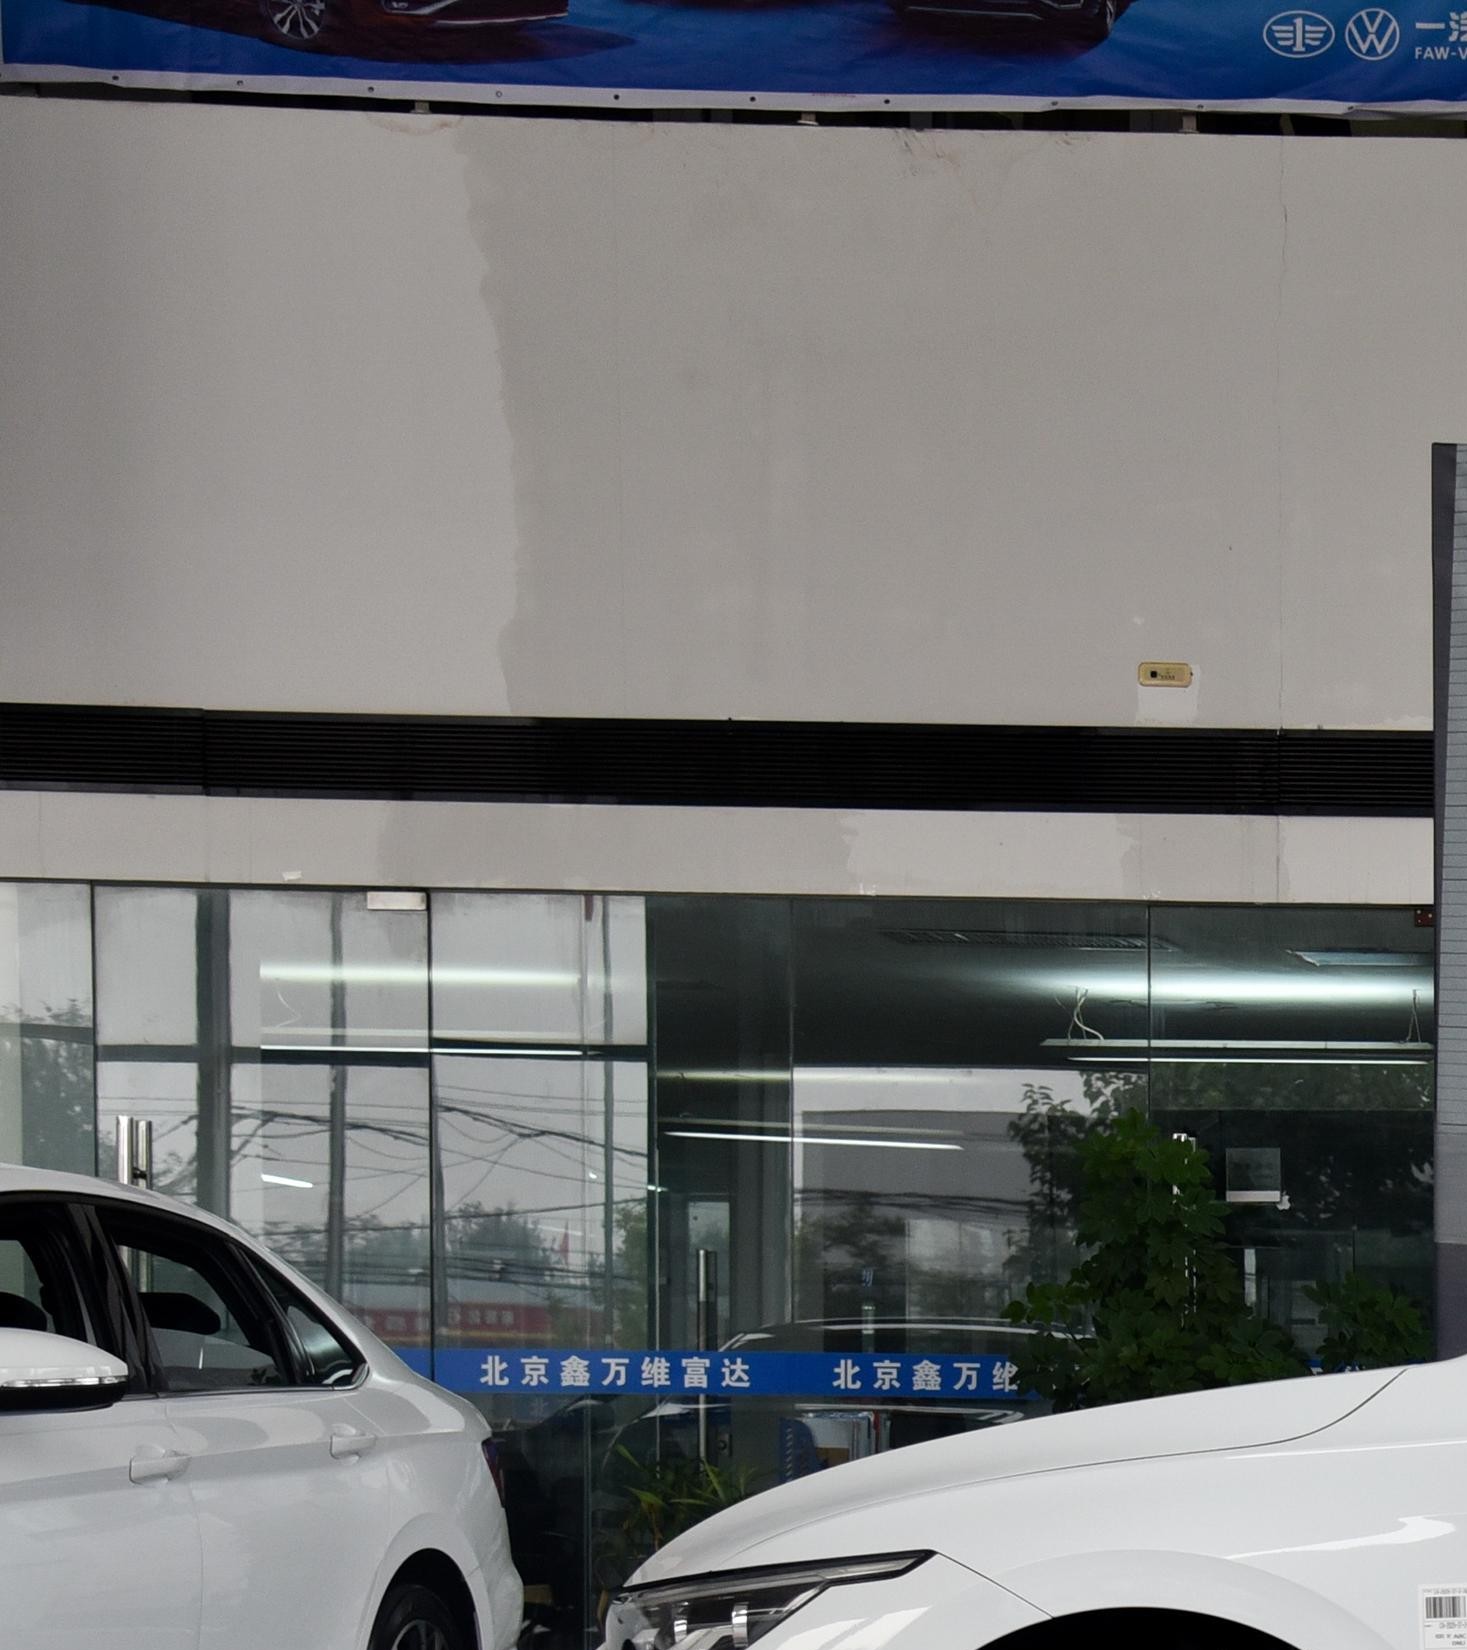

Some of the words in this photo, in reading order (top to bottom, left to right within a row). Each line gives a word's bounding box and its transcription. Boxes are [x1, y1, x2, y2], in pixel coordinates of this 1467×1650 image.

[480, 1355, 751, 1389] 北京鑫万维富达
